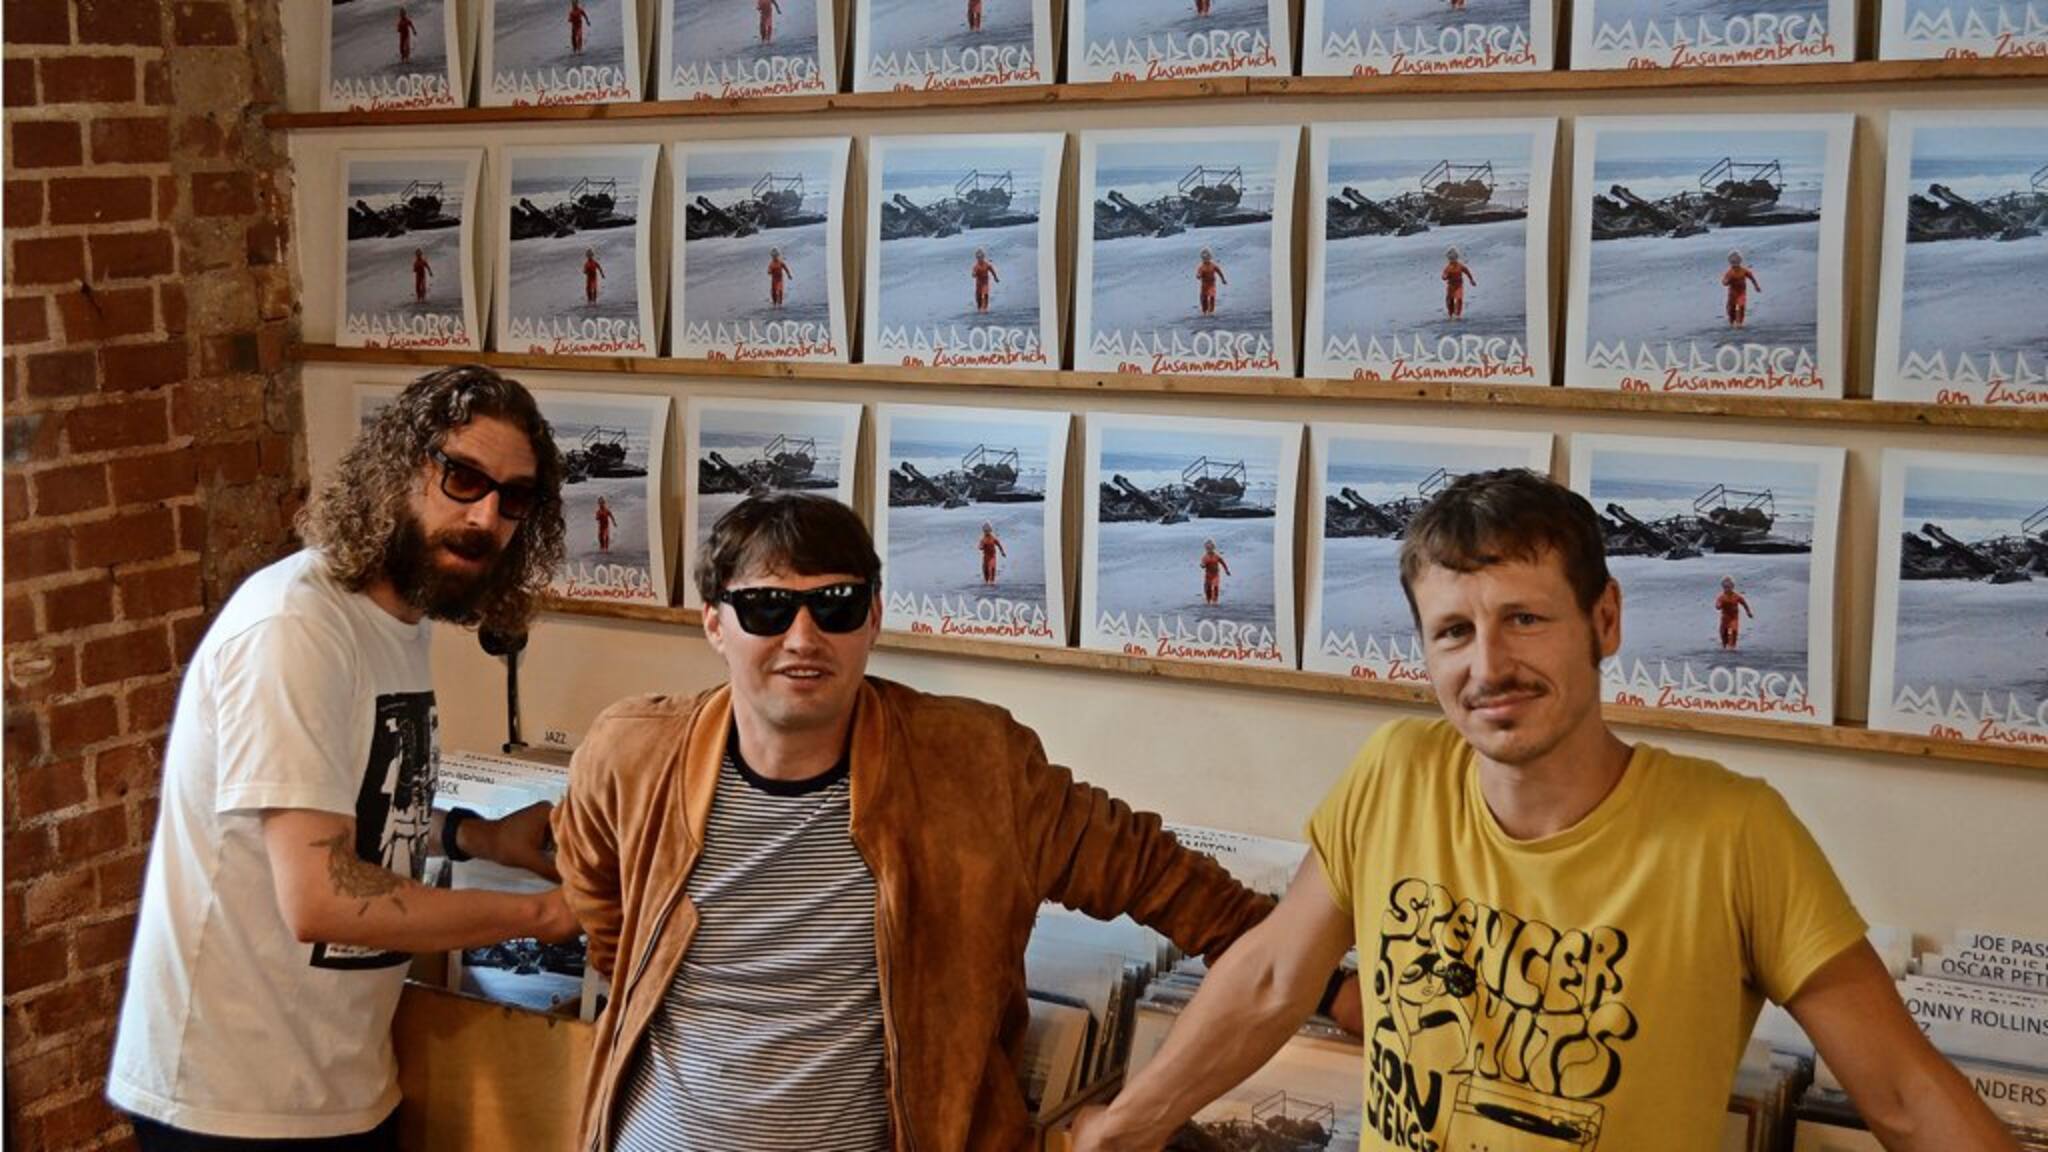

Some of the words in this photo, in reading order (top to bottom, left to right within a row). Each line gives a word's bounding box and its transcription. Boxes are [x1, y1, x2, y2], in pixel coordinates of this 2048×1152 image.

[1324, 24, 1530, 58] MALLORCA
[1592, 13, 1827, 49] MALLORCA
[870, 45, 1032, 77] MALLORCA
[1086, 29, 1270, 66] MALLORCA
[1392, 43, 1536, 75] Zusammenbruch
[1669, 33, 1834, 70] Zusammenbruch
[672, 56, 819, 87] MALLORCA
[924, 63, 1040, 91] Zusammenbruch
[1147, 49, 1276, 82] Zusammenbruch
[333, 74, 449, 99] MALLORCA
[494, 66, 625, 94] MALLORCA
[537, 80, 631, 107] Zusammenbruch
[720, 67, 825, 99] Zusammenbruch
[371, 84, 455, 112] Zusammenbruch
[347, 313, 465, 335] MALLORCA
[510, 316, 640, 341] MALLORCA
[685, 320, 830, 345] MALLORCA
[387, 331, 470, 349] Zusammenbruch
[529, 344, 546, 355] am
[553, 335, 646, 354] Zusammenbruch
[707, 350, 727, 361] am
[734, 338, 836, 361] Zusammenbruch
[879, 326, 1039, 353] MALLORCA
[1089, 330, 1272, 358] MALLORCA
[1323, 333, 1527, 364] MALLORCA
[902, 356, 924, 368] am
[932, 344, 1046, 367] Zusammenbruch
[1118, 361, 1143, 374] am
[1152, 350, 1279, 375] Zusammenbruch
[1353, 367, 1380, 381] am
[1391, 354, 1534, 381] Zusammenbruch
[1587, 341, 1817, 376] MALLORCA
[1899, 350, 2048, 385] MALL
[1620, 376, 1651, 391] am
[1663, 362, 1824, 391] Zusammenbruch
[1937, 389, 1970, 405] am
[566, 580, 658, 599] Zusammenbruch
[887, 592, 1046, 625] MALLORCA
[911, 621, 933, 634] am
[941, 616, 1053, 639] Zusammenbruch
[1097, 611, 1275, 648] MALLORCA
[1123, 642, 1148, 656] am
[1157, 637, 1282, 662] Zusammenbruch
[1351, 664, 1377, 680] am
[1616, 690, 1645, 706] am
[1658, 685, 1815, 716] Zusammenbruch
[545, 731, 567, 745] JAZZ
[1930, 723, 1963, 740] am
[1380, 877, 1629, 1015] SPENCER
[1972, 934, 2005, 952] JOE
[2011, 939, 2048, 958] PAS
[1941, 958, 2005, 981] OSCAR
[2011, 969, 2048, 988] PET
[1468, 985, 1638, 1098] HITS
[1371, 1038, 1442, 1133] JON
[1976, 1078, 2047, 1106] NDERS
